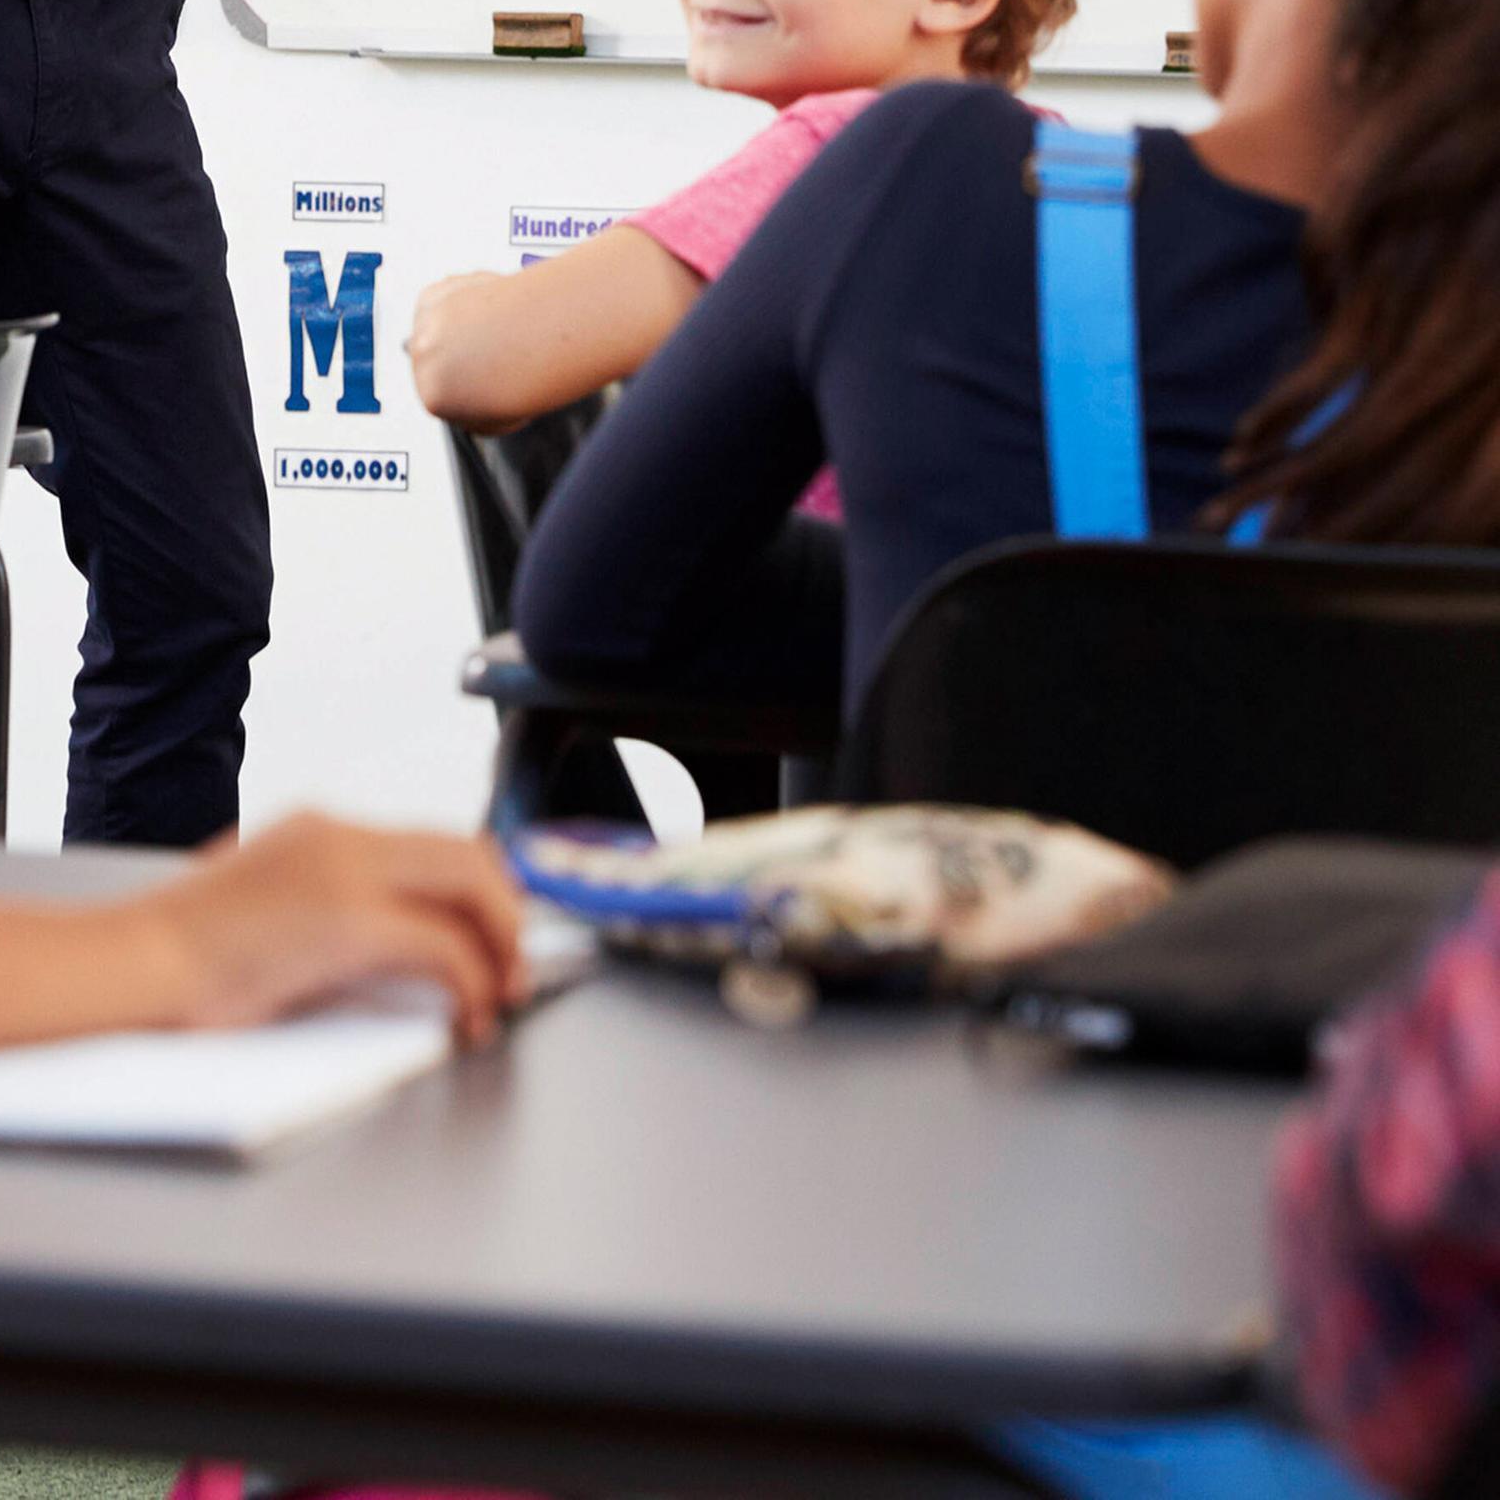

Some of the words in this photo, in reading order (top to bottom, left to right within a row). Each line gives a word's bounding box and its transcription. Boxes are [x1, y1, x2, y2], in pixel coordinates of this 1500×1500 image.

[296, 190, 382, 213] Millions
[284, 250, 383, 414] M
[281, 457, 407, 482] 1,000,000.
